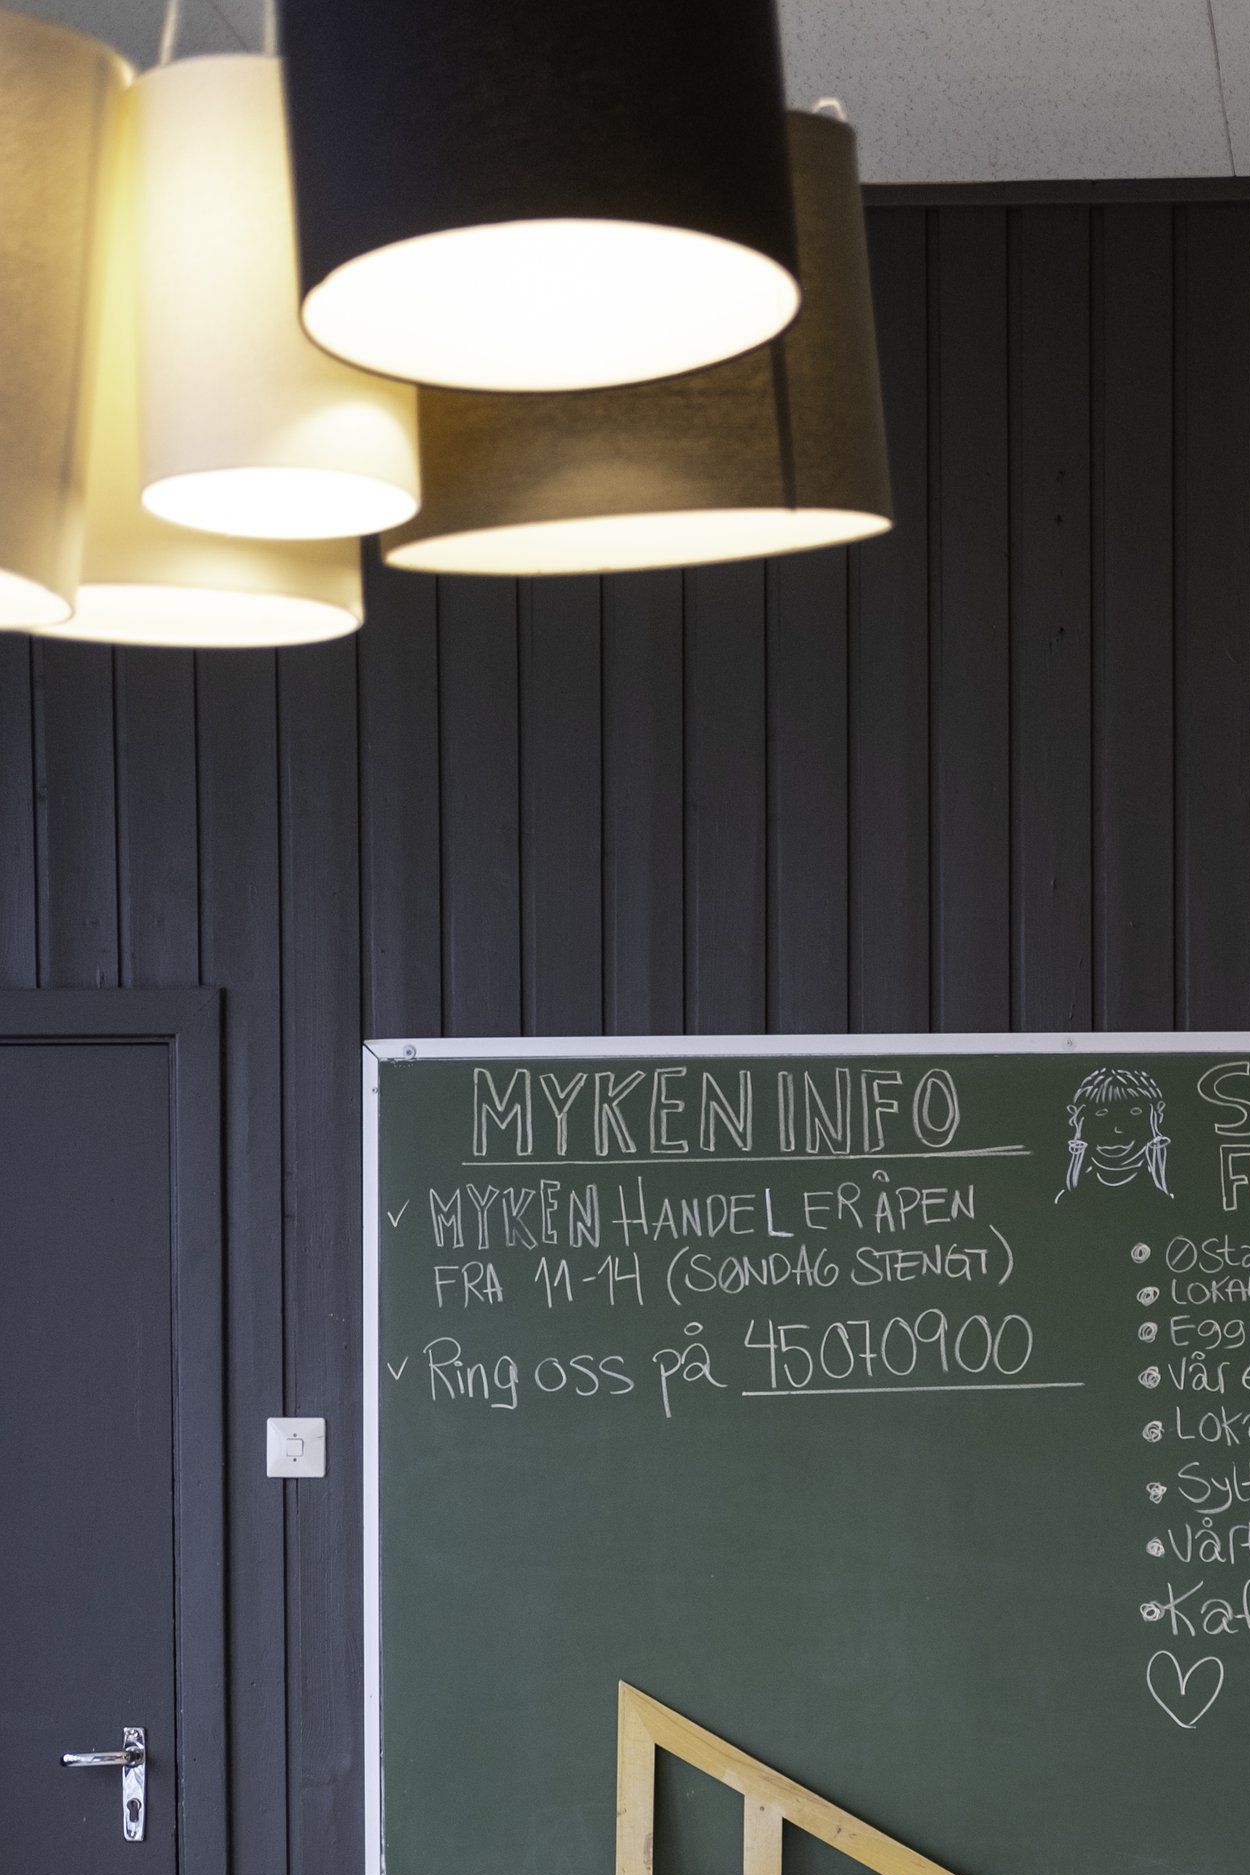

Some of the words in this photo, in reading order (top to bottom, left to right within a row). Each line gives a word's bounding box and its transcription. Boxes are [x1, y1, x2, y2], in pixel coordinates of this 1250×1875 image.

[473, 1067, 753, 1156] MYKEN
[779, 1068, 961, 1155] INFO
[429, 1179, 600, 1250] MYKEN
[611, 1176, 795, 1247] HANDEL
[804, 1181, 863, 1230] ER
[872, 1169, 976, 1234] ÅPEN
[434, 1260, 504, 1309] FRA
[534, 1251, 644, 1309] 11-14
[851, 1224, 1014, 1286] STENGT)
[424, 1337, 518, 1409] Ring
[535, 1354, 635, 1396] oss
[653, 1322, 728, 1418] på
[743, 1309, 1034, 1389] 45070900
[1168, 1351, 1231, 1394] Vår
[1170, 1315, 1246, 1350] Egg
